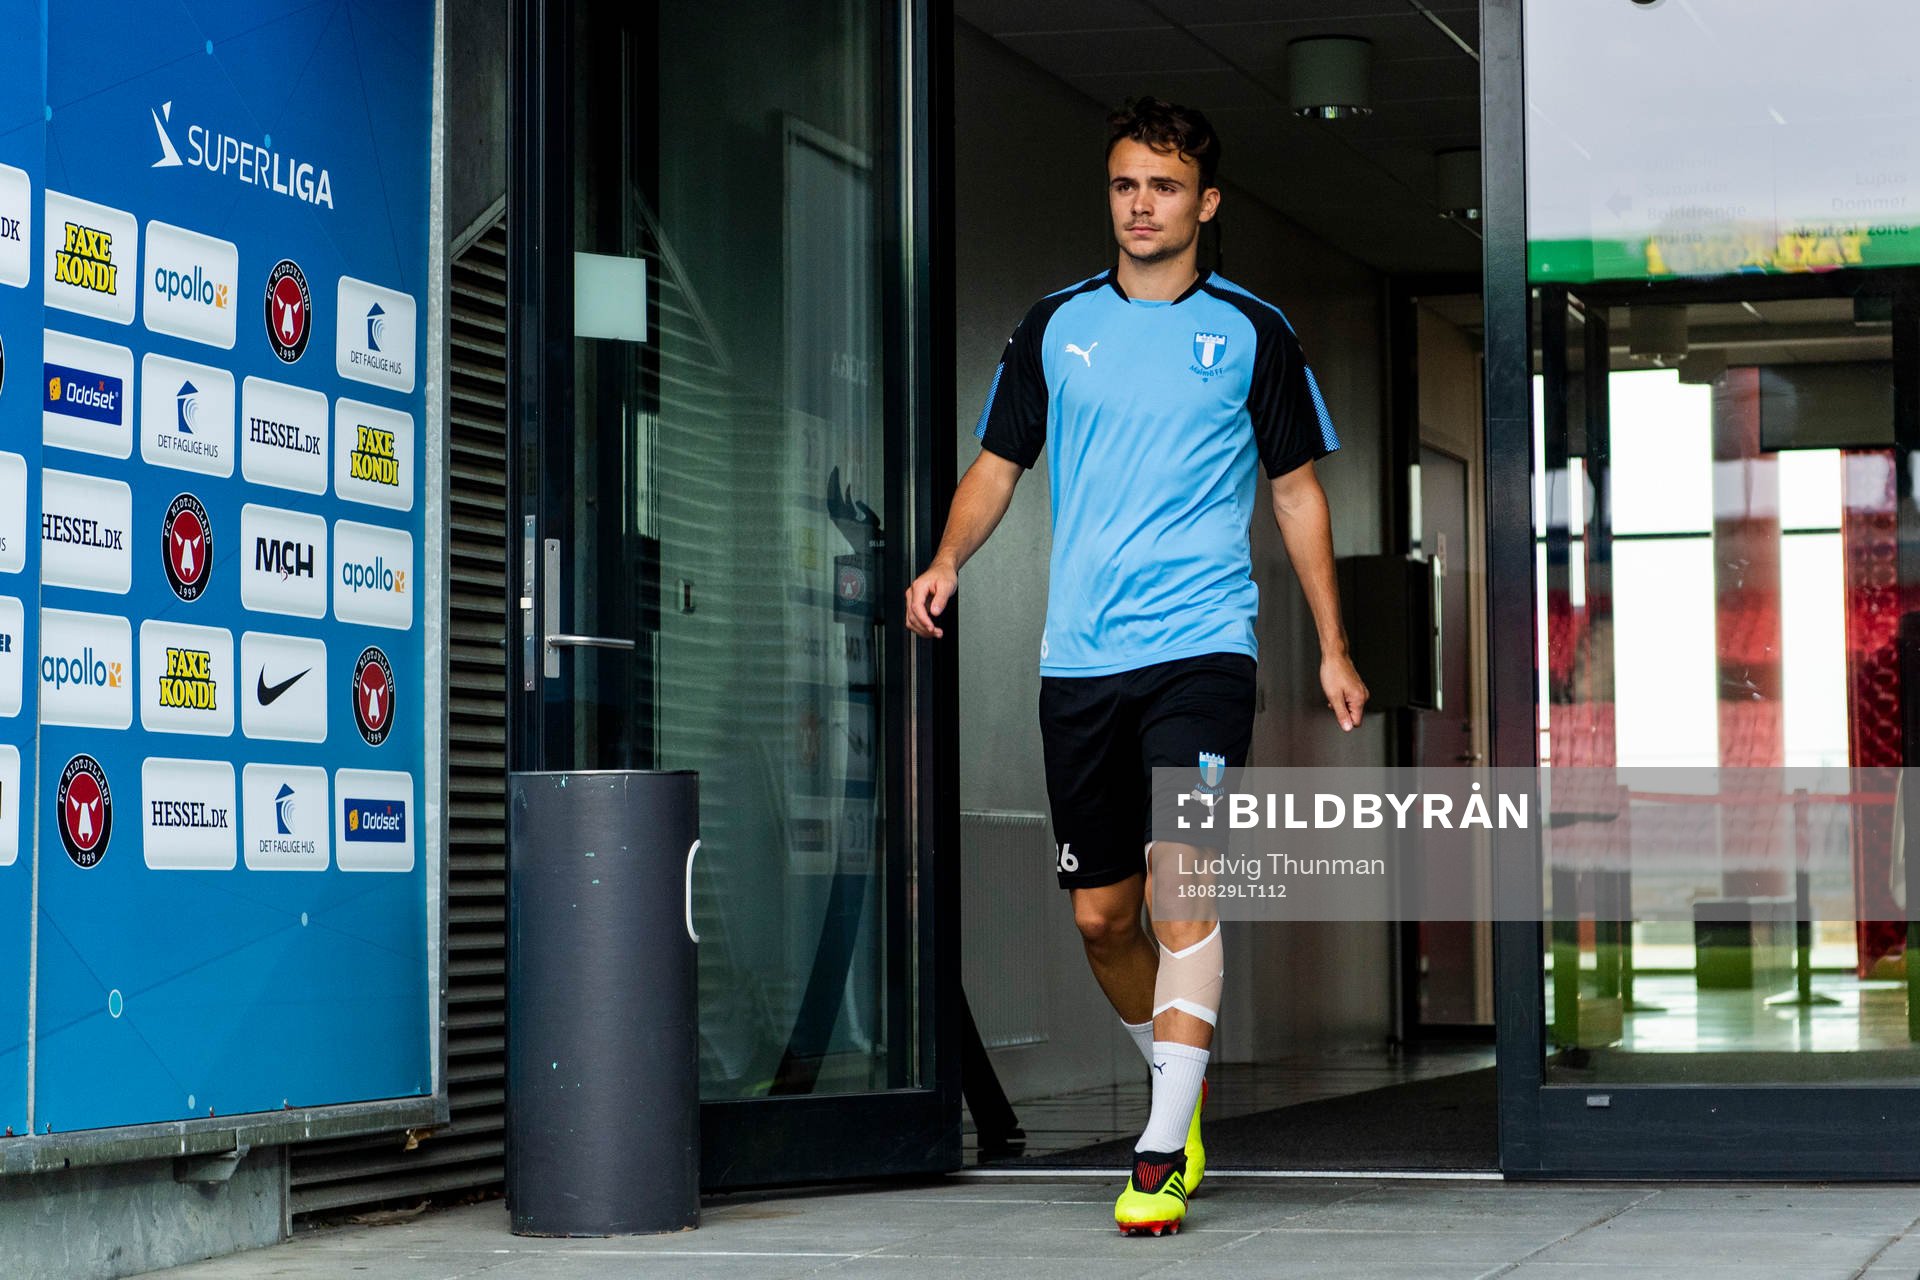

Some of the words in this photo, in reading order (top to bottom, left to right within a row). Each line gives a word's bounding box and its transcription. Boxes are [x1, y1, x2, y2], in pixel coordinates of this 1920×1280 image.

[188, 125, 334, 209] SUPERLIGA
[65, 222, 112, 262] FAXE
[1866, 222, 1909, 236] zone
[56, 252, 117, 295] KONDI
[155, 265, 213, 305] apollo
[274, 263, 310, 311] MIDTJYLLAND
[279, 346, 295, 360] 1999
[351, 350, 362, 365] DET
[363, 354, 388, 371] FAGLIGE
[389, 361, 402, 375] HUS
[66, 381, 115, 410] Oddset
[158, 434, 171, 448] DET
[173, 437, 202, 455] FAGLIGE
[204, 444, 218, 458] HUS
[250, 418, 320, 455] HESSEL.DK
[356, 424, 394, 457] FAXE
[351, 448, 399, 486] KONDI
[172, 498, 211, 545] MIDTJYLLAND
[255, 537, 314, 578] MCH
[343, 556, 393, 592] apollo
[179, 585, 196, 598] 1999
[42, 647, 107, 690] apollo
[166, 647, 210, 679] FAXE
[160, 675, 216, 710] KONDI
[367, 730, 382, 743] 1999
[59, 786, 66, 803] FC
[66, 759, 110, 806] MIDTJYLLAND
[152, 801, 228, 829] HESSEL.DK
[362, 810, 400, 831] Oddset
[77, 852, 96, 864] 1999
[260, 840, 272, 853] DET
[273, 841, 300, 853] FAGLIGE
[301, 842, 315, 854] HUS
[1056, 843, 1079, 872] 6
